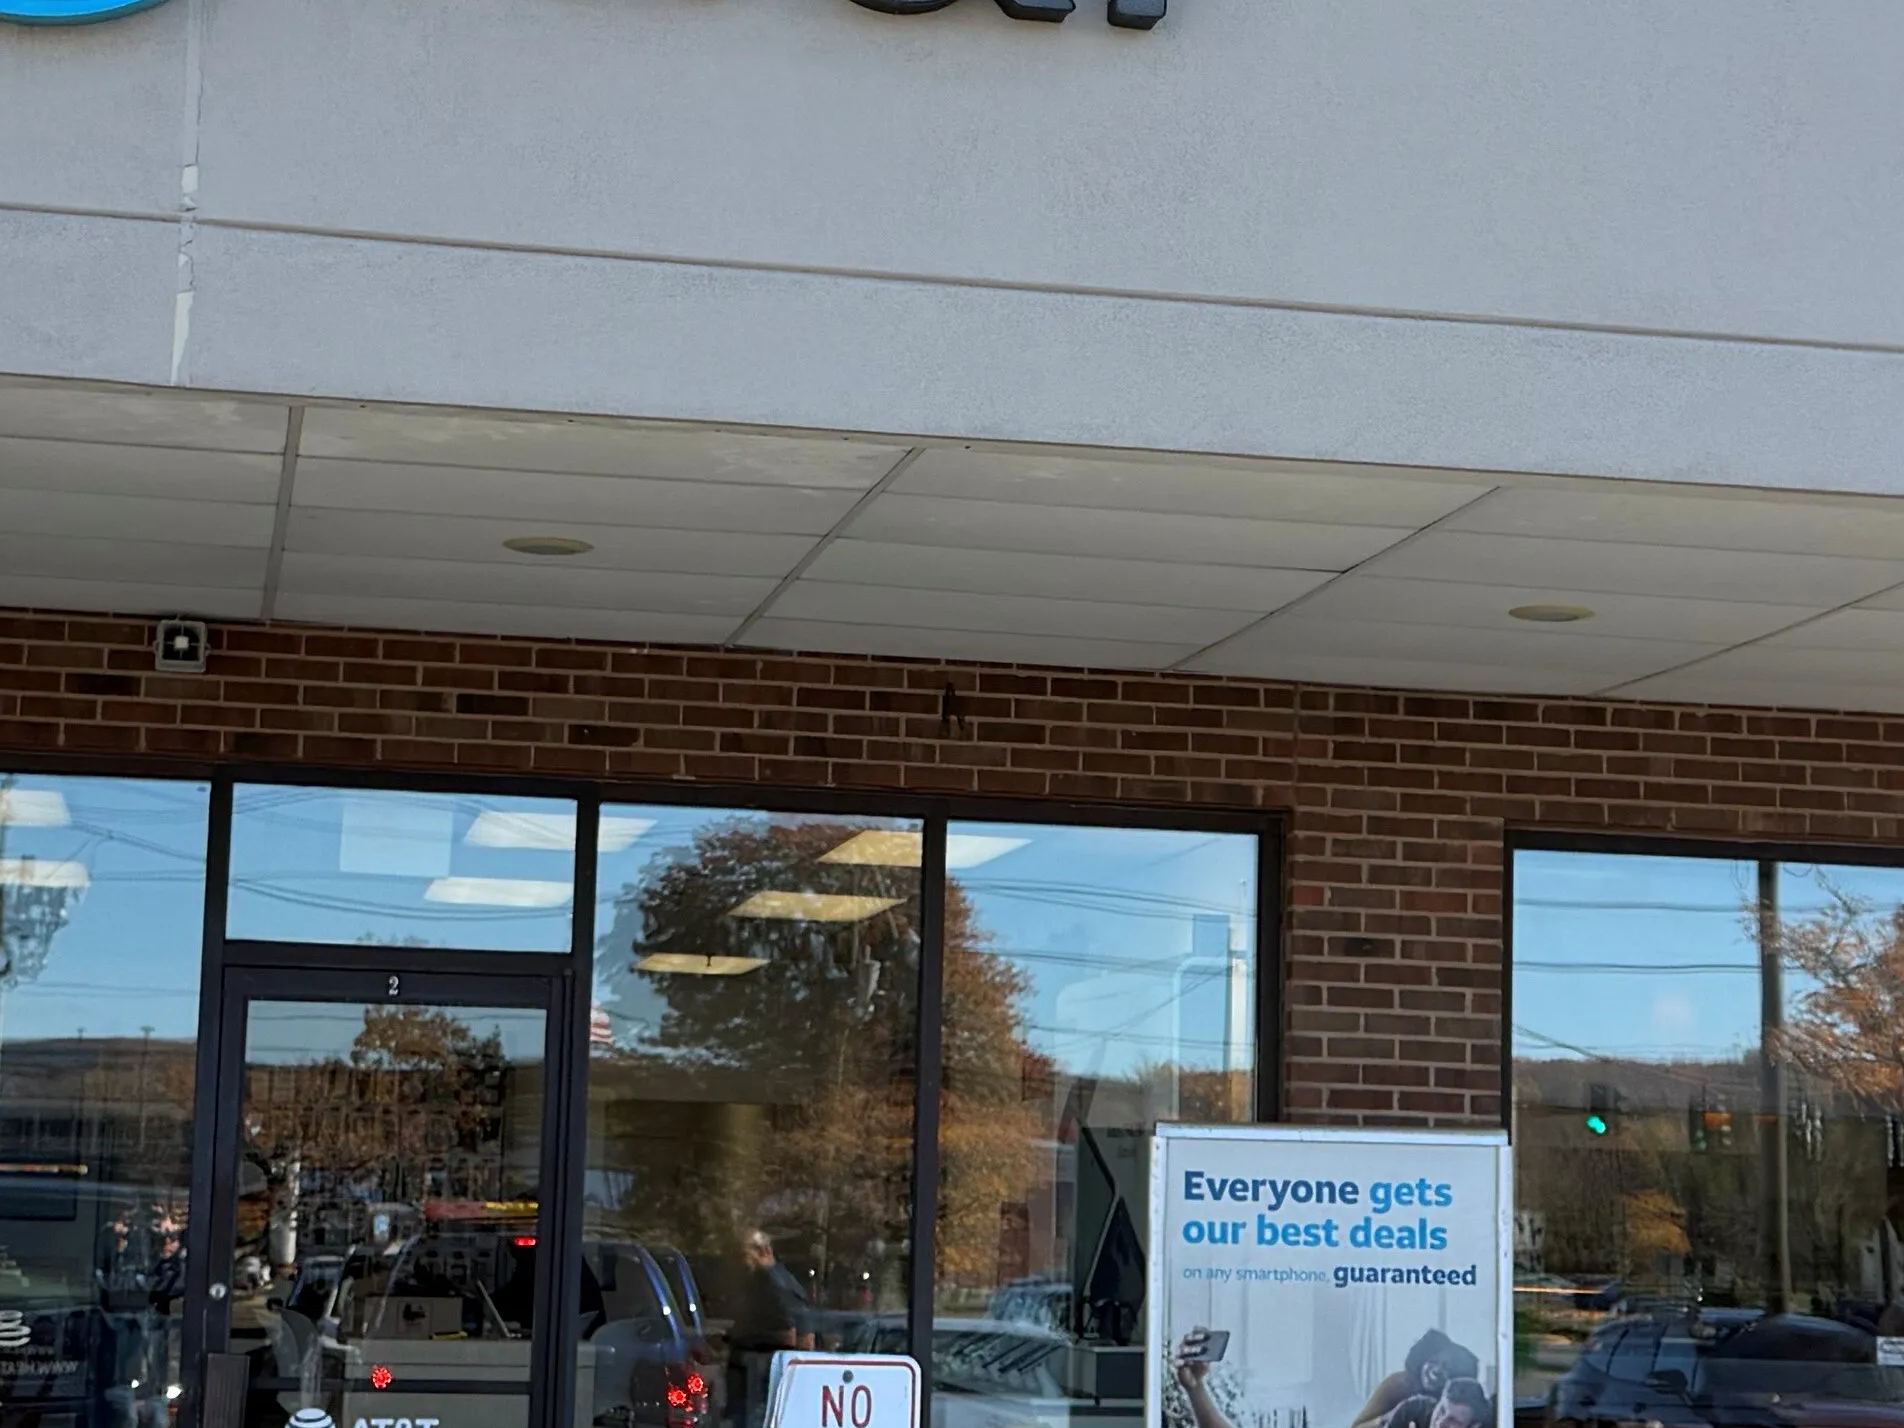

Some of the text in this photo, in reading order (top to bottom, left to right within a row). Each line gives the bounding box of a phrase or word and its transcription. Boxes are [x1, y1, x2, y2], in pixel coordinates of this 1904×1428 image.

[388, 975, 399, 996] 2
[1183, 1170, 1454, 1215] Everyone gets
[1182, 1213, 1448, 1250] our best deals
[1182, 1267, 1202, 1279] on
[1206, 1267, 1232, 1283] any
[1332, 1264, 1478, 1289] guaranteed
